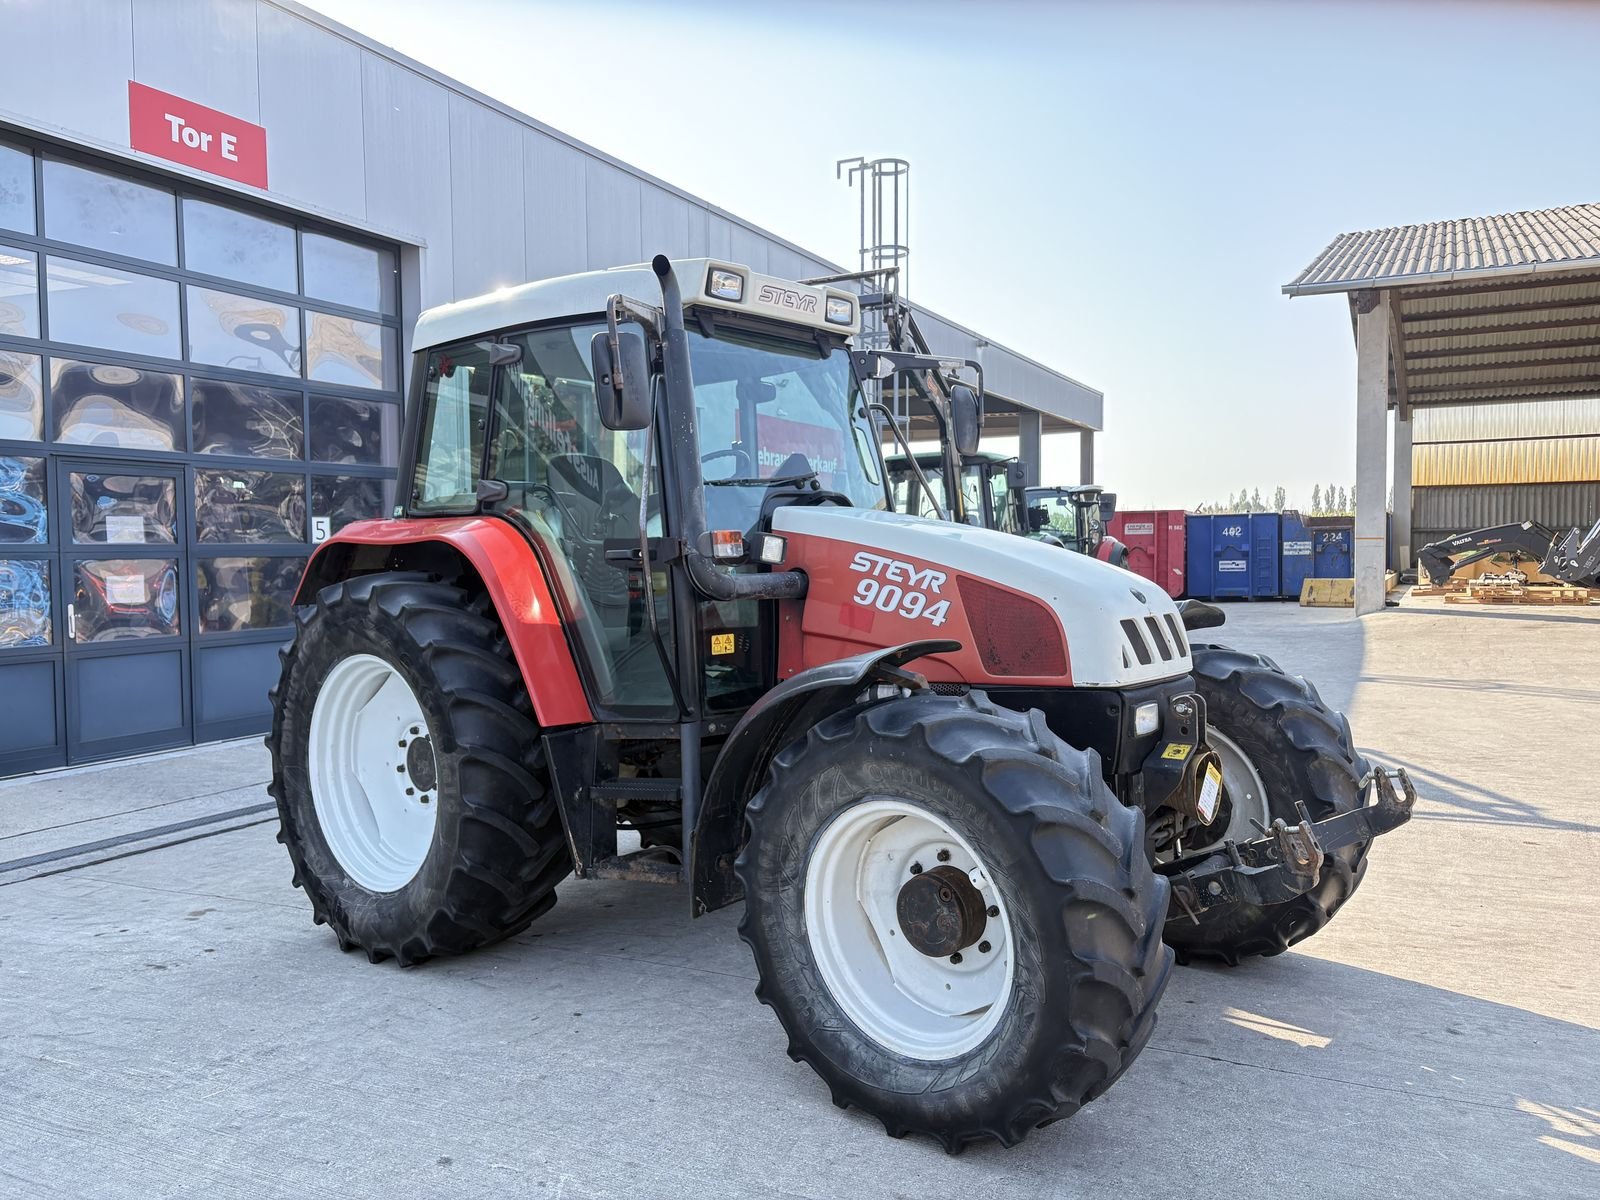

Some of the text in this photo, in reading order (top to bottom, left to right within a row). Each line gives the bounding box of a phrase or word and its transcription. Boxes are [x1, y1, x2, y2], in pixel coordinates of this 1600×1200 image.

[164, 113, 239, 163] Tor E
[759, 285, 818, 313] STEYR
[316, 520, 326, 541] 5
[849, 551, 948, 594] STEYR
[853, 578, 952, 627] 9094
